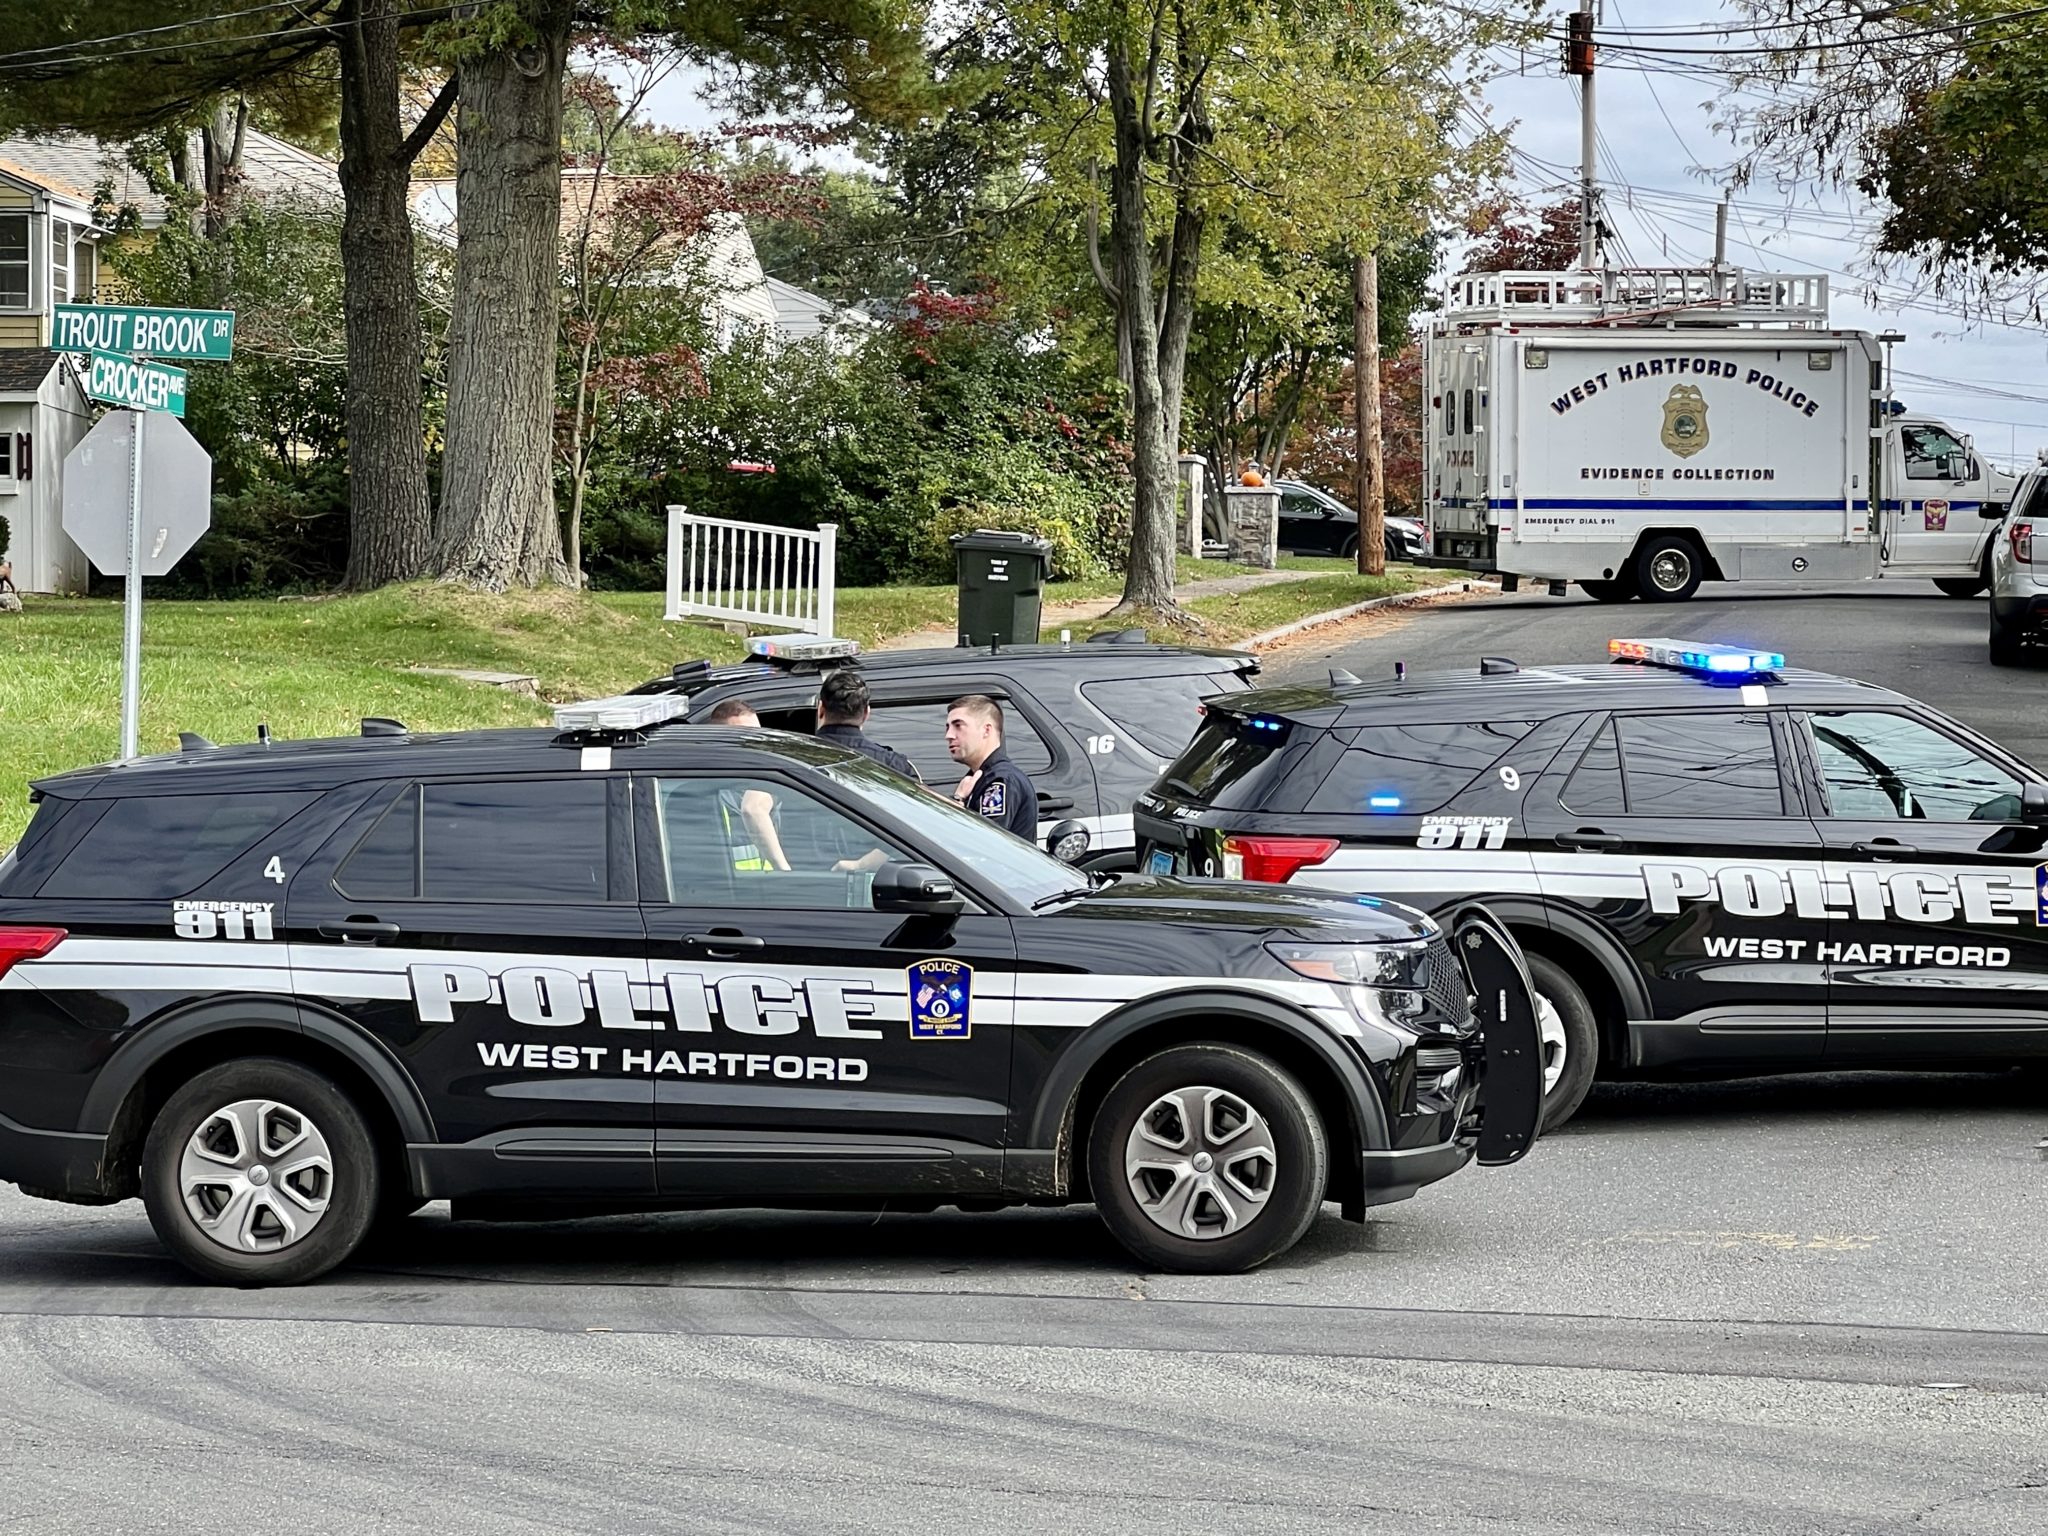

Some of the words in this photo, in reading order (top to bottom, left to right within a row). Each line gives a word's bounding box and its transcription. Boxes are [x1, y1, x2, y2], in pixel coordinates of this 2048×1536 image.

[57, 311, 127, 349] TROUT
[133, 315, 209, 353] BROOK
[212, 318, 229, 338] DR
[91, 356, 169, 409] CROCKER
[168, 375, 185, 396] AVE
[1550, 371, 1609, 417] WEST
[1617, 357, 1738, 384] HARTFORD
[1745, 368, 1820, 418] POLICE
[1580, 467, 1665, 480] EVIDENCE
[1672, 468, 1775, 481] COLLECTION
[1087, 734, 1115, 755] 16
[1499, 765, 1521, 792] 9
[1172, 806, 1204, 820] POLICE
[1421, 815, 1514, 826] EMERGENCY
[1416, 824, 1509, 850] 911
[263, 855, 286, 884] 4
[1204, 857, 1214, 878] 9
[173, 900, 275, 912] EMERGENCY
[1641, 863, 2020, 926] POLICE
[173, 910, 275, 940] 911
[1702, 936, 1807, 961] WEST
[1816, 941, 2012, 968] HARTFORD
[918, 961, 961, 975] POLICE
[408, 963, 884, 1041] POLICE
[476, 1042, 607, 1071] WEST
[621, 1047, 870, 1084] HARTFORD
